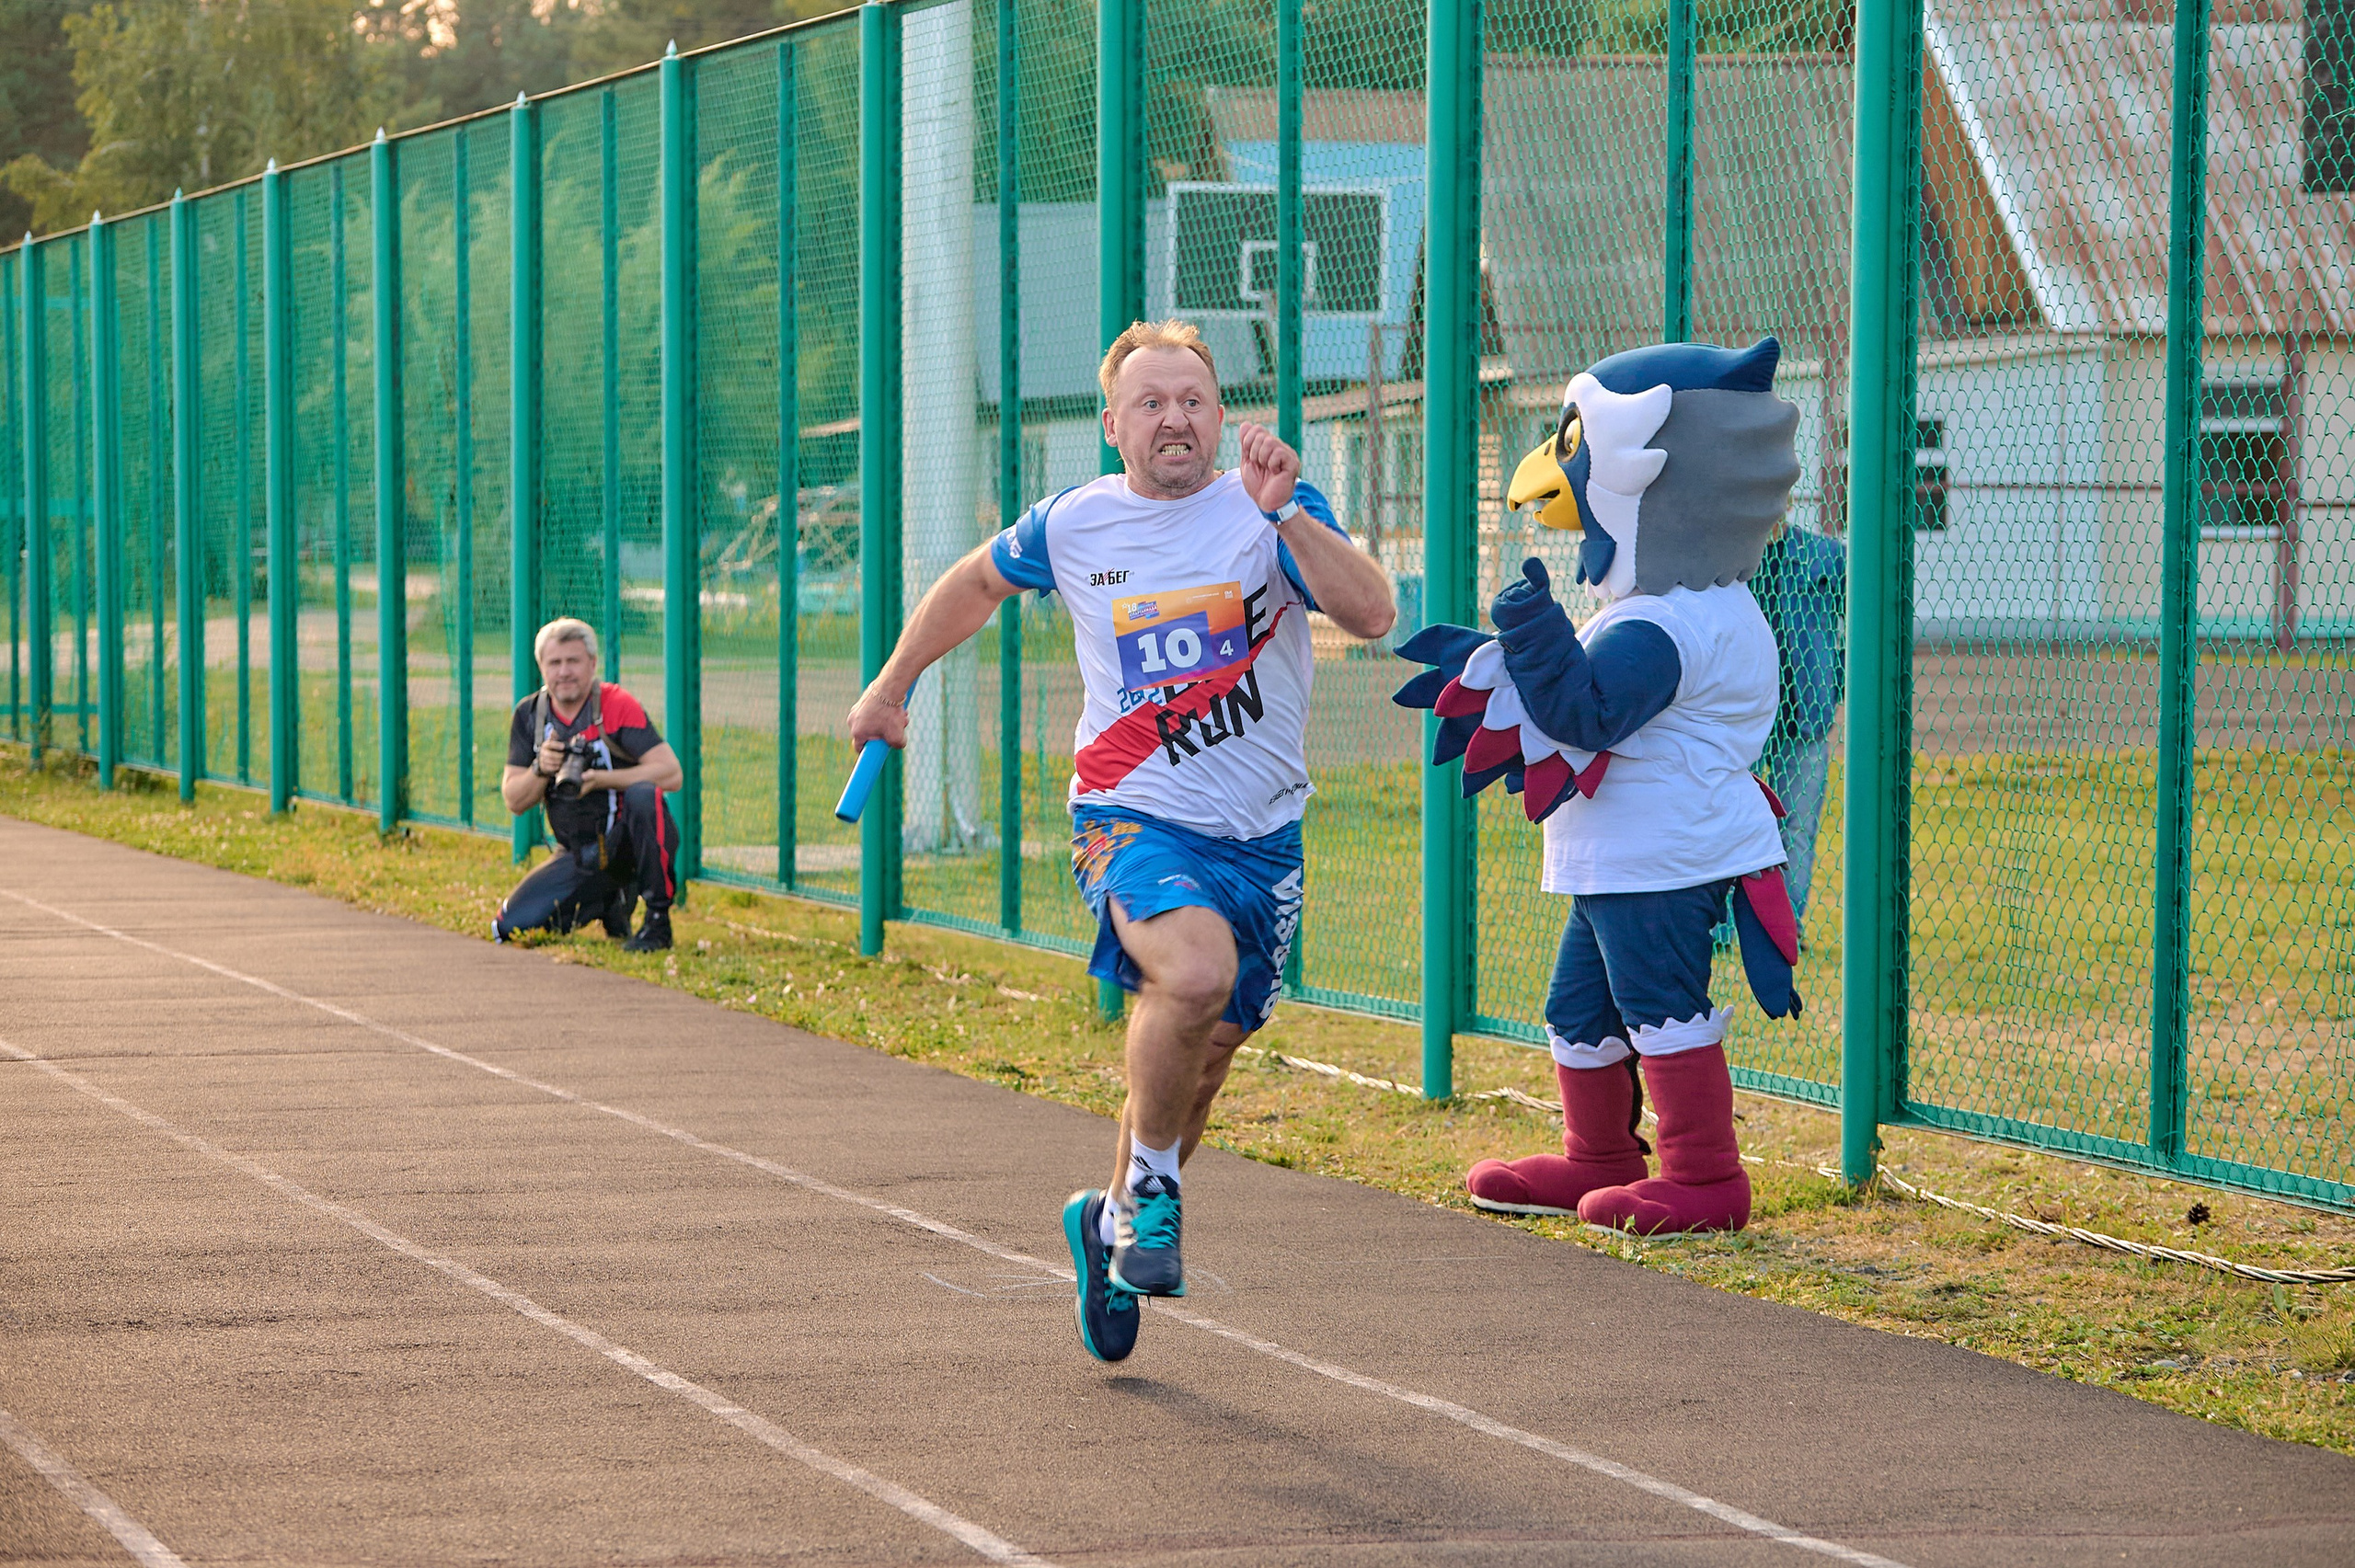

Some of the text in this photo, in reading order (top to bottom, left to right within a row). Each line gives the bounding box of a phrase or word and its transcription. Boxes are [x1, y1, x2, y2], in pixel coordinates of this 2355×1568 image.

[1127, 602, 1137, 613] 18
[1137, 627, 1235, 673] 10 4
[1155, 664, 1264, 767] RUN
